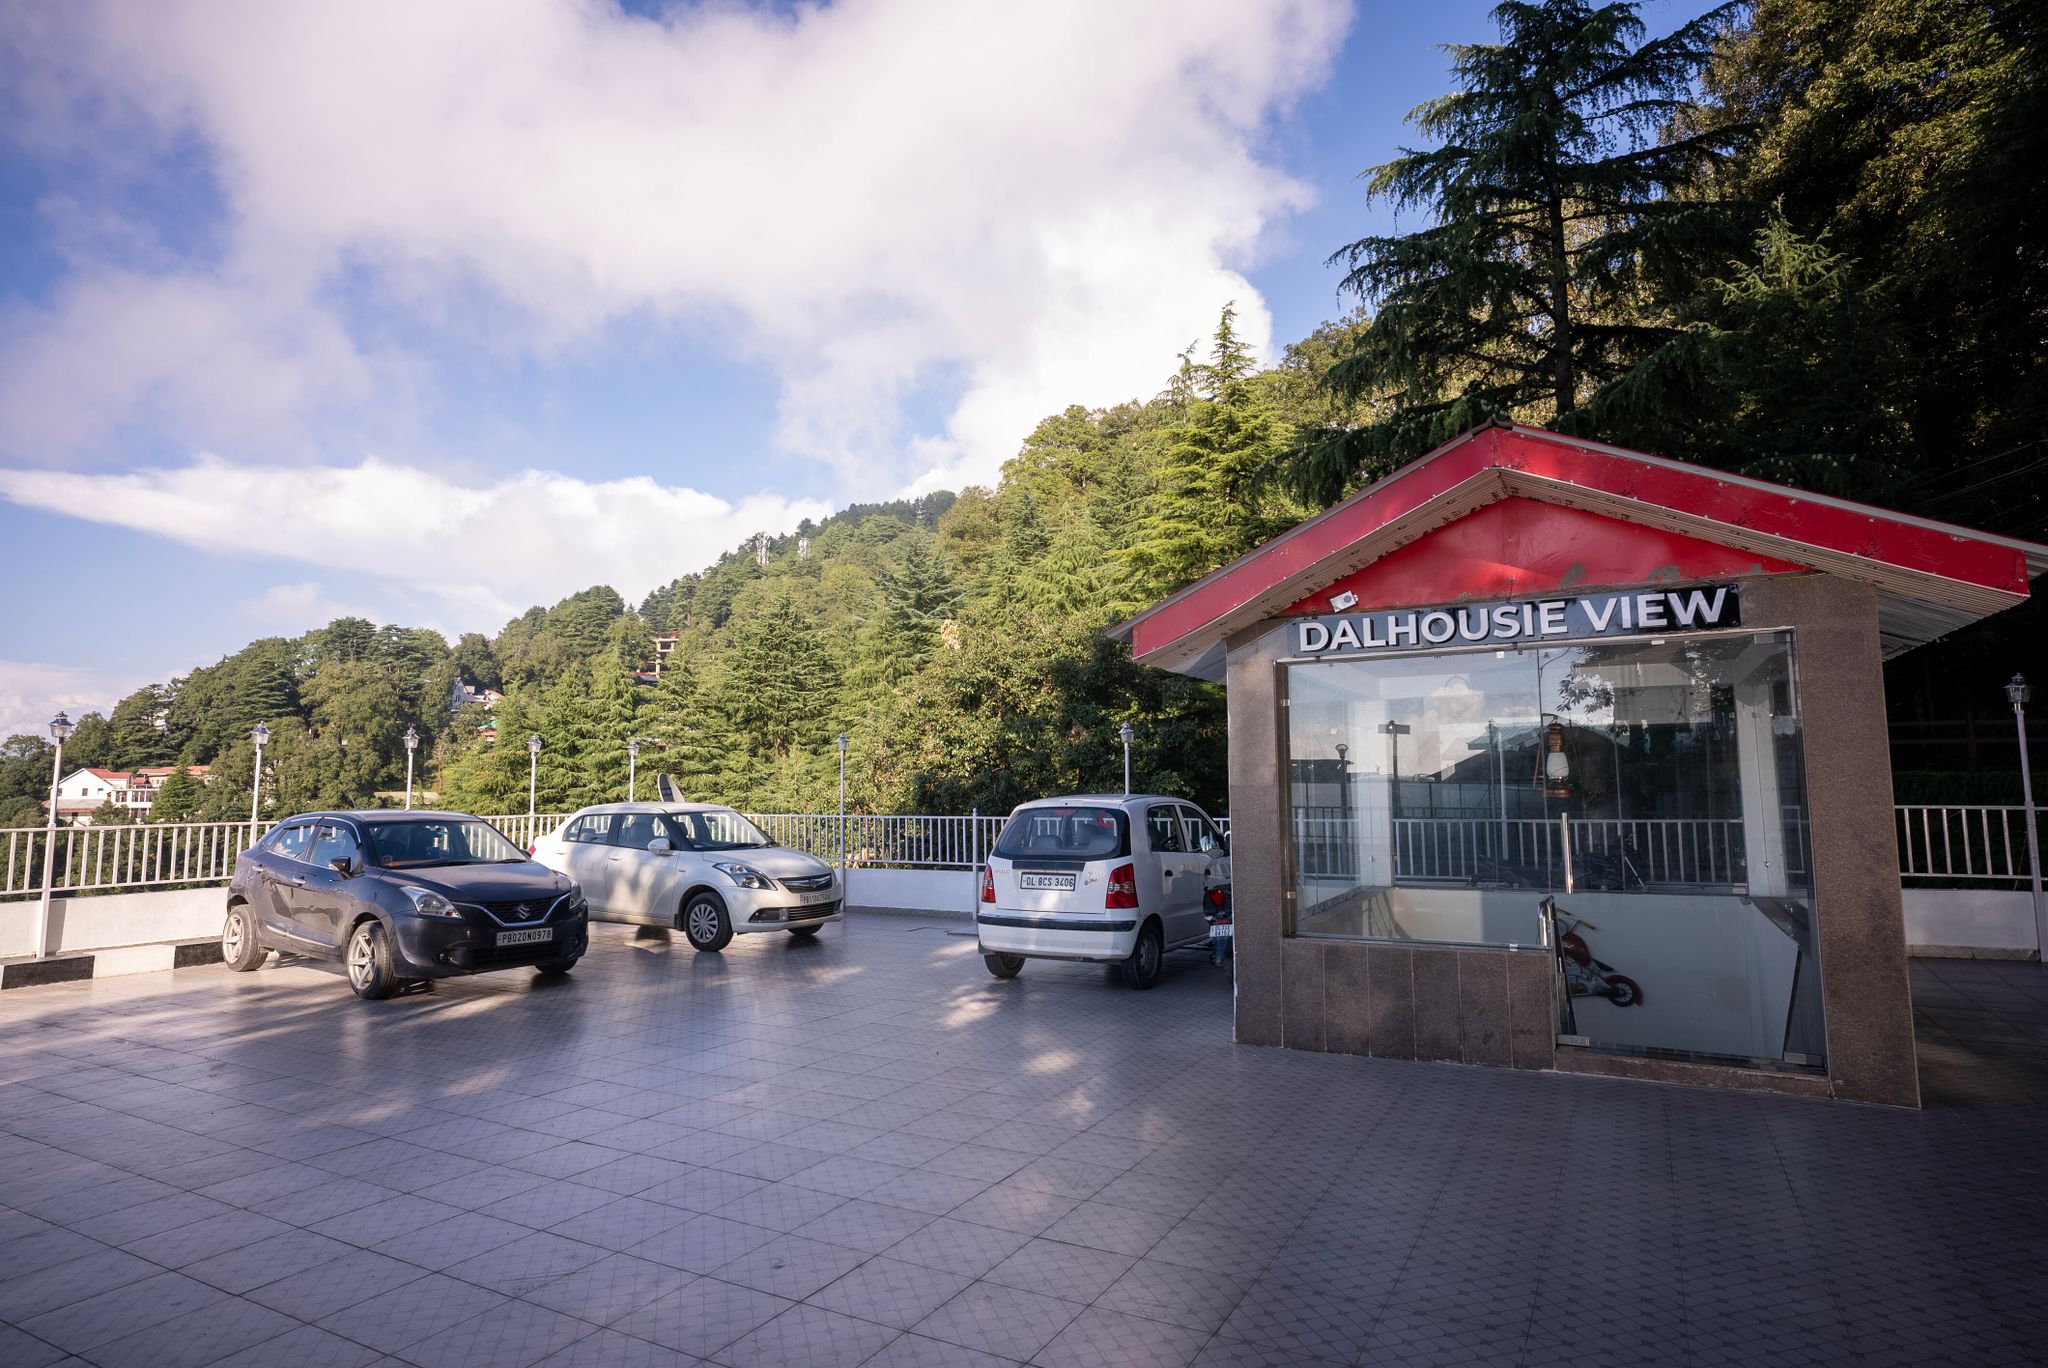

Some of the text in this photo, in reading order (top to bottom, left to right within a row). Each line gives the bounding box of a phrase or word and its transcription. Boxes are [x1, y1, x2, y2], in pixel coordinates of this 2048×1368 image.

[1299, 587, 1728, 652] DALHOUSIE VIEW
[1026, 877, 1036, 886] DL
[1038, 877, 1052, 887] 8CS
[1055, 878, 1074, 888] 3406
